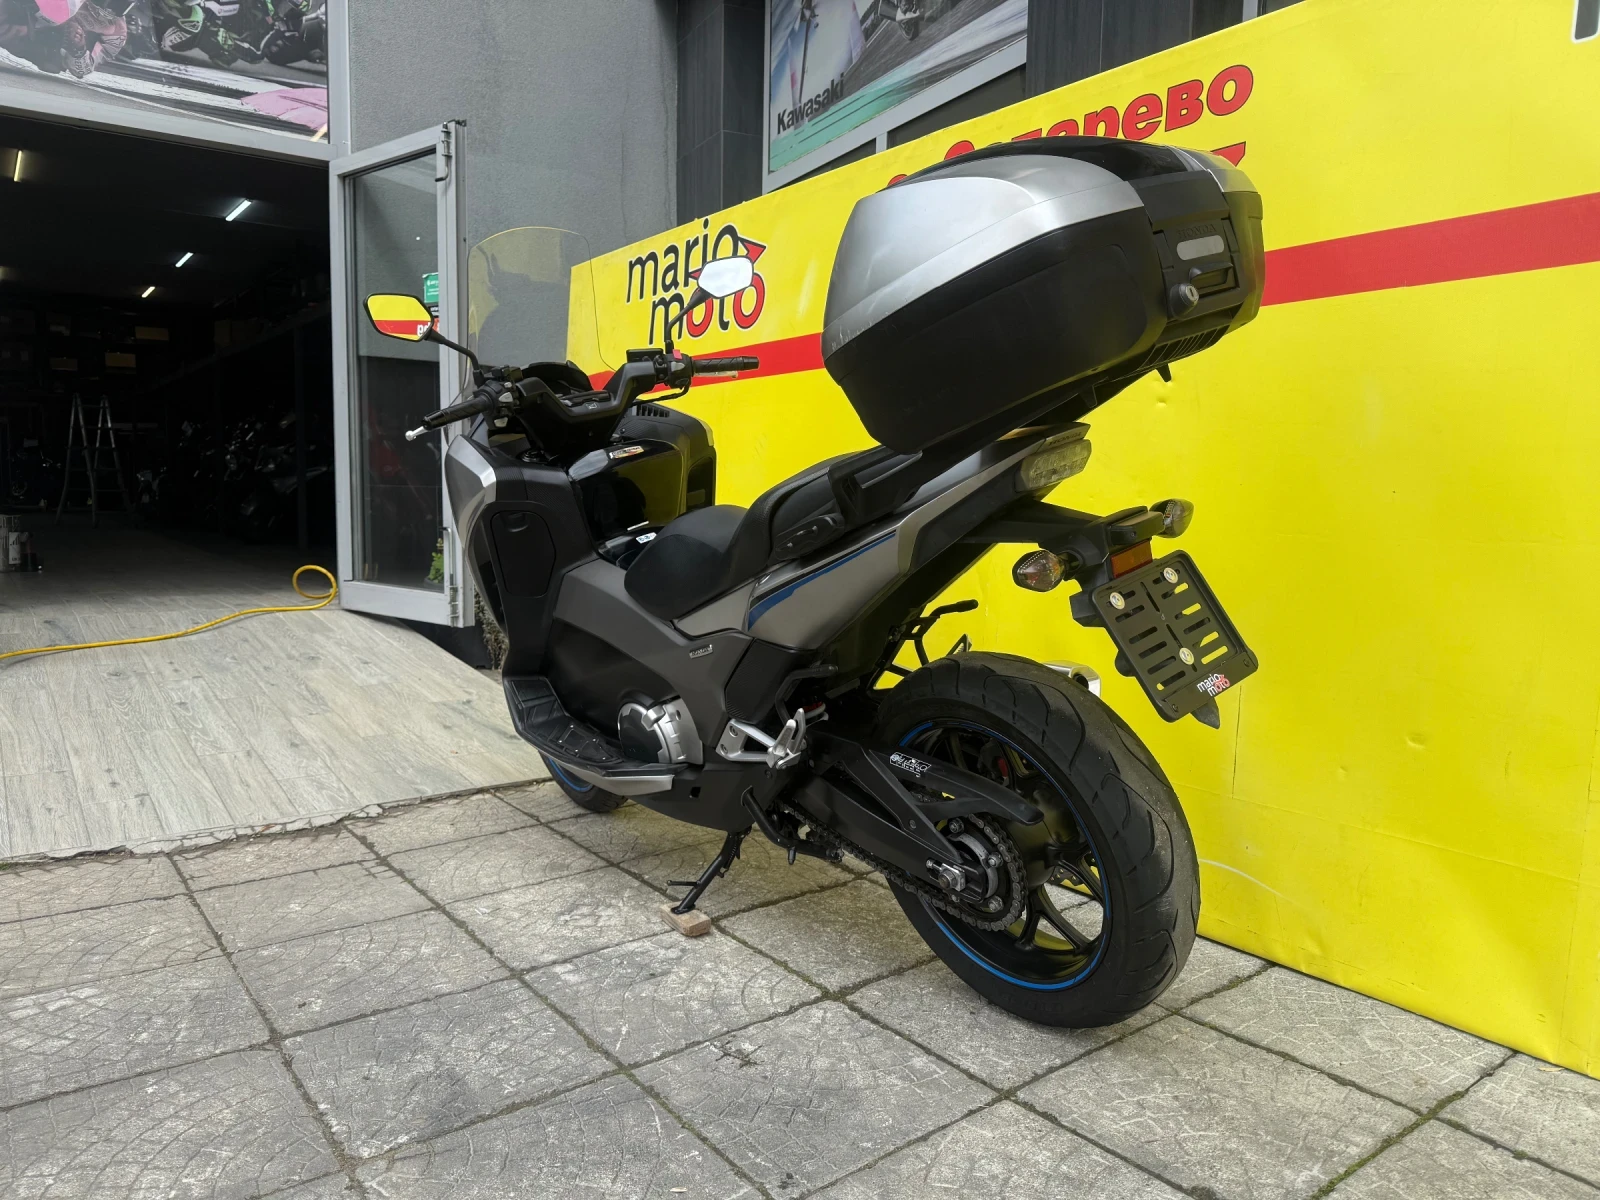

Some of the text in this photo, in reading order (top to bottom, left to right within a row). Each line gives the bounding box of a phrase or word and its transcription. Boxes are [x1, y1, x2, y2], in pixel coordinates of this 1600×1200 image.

[777, 72, 844, 135] Kawasaki
[627, 217, 739, 303] mario
[1196, 673, 1220, 692] mario
[1207, 678, 1230, 696] moto
